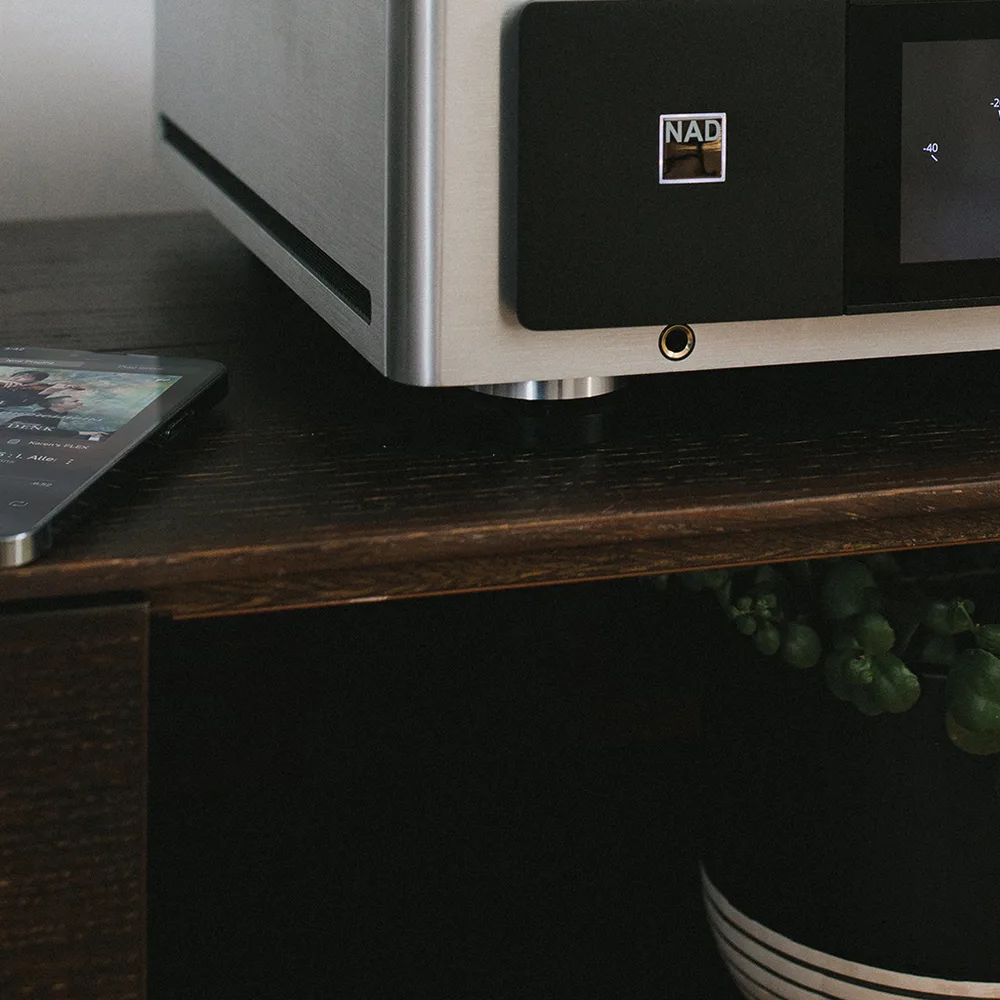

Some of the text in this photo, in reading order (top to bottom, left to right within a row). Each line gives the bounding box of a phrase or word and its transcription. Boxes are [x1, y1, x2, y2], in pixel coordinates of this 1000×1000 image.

[665, 120, 721, 143] NAD
[922, 143, 939, 153] -40
[7, 423, 54, 432] DENK
[28, 440, 61, 448] Karen's
